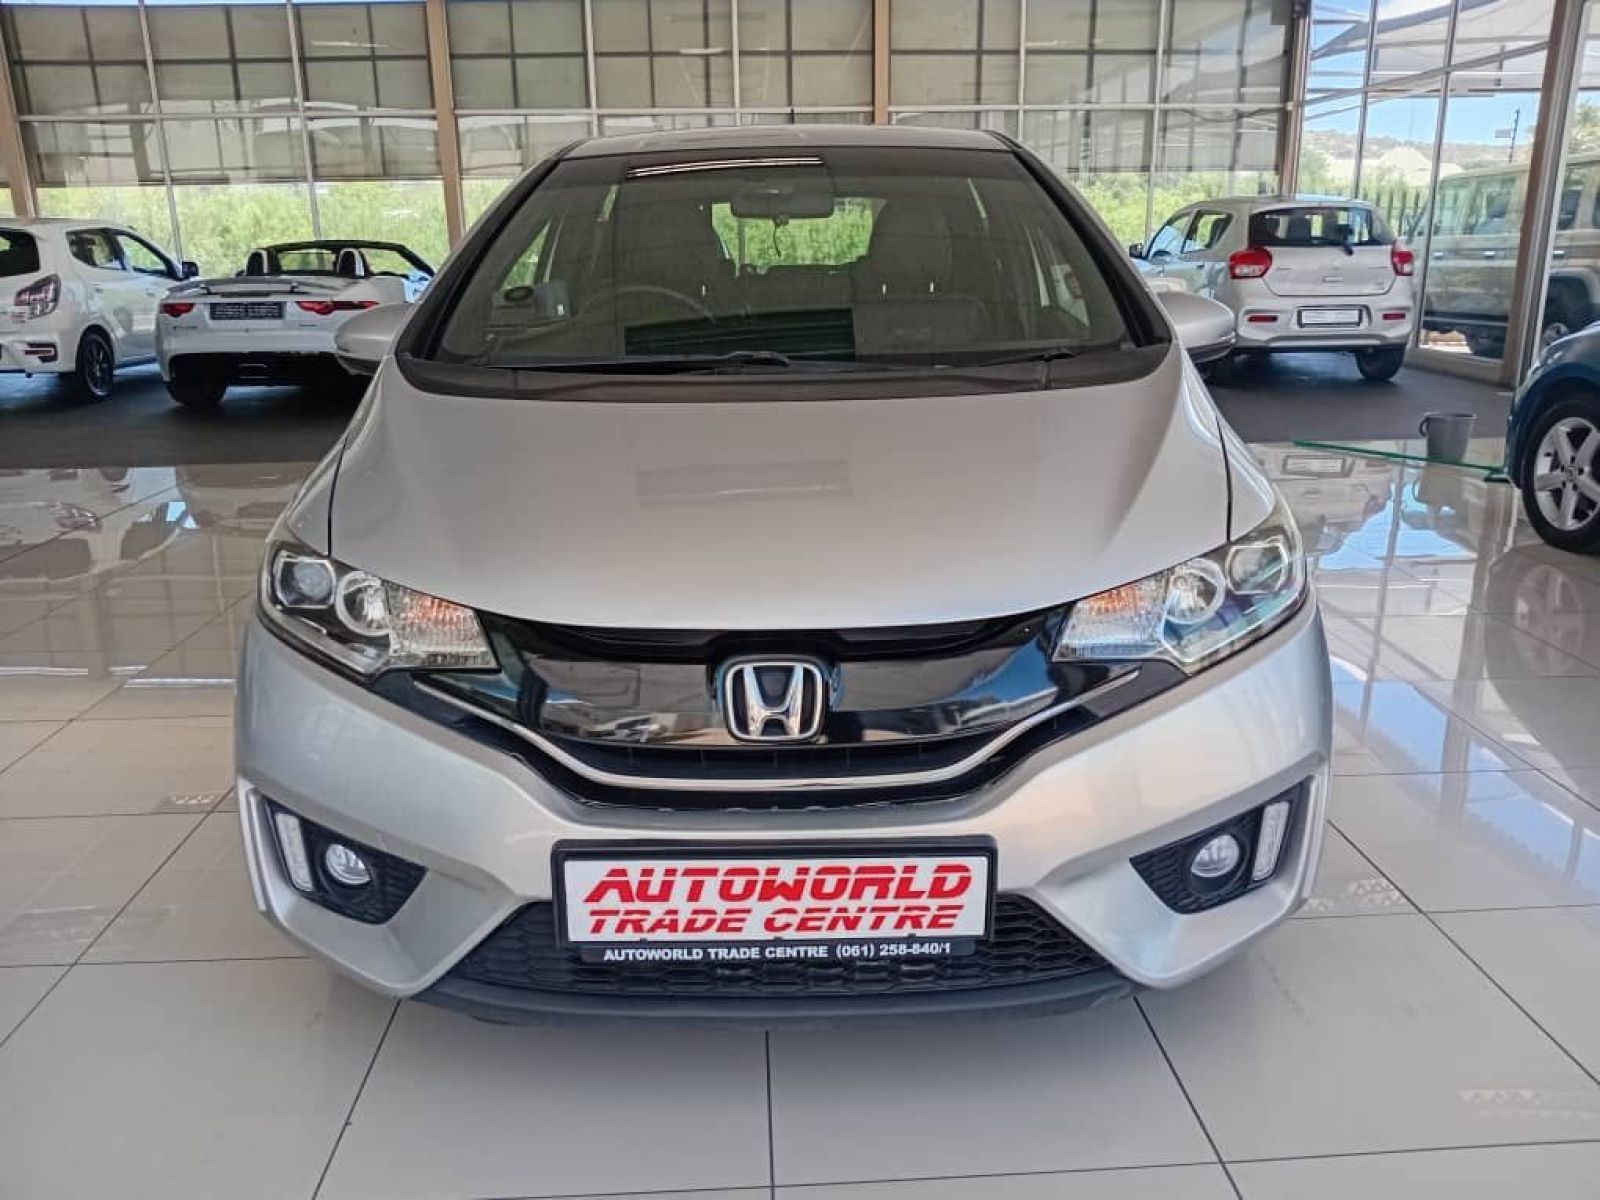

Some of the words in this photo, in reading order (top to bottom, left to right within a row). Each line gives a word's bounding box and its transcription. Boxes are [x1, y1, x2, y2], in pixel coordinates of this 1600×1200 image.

[583, 864, 972, 903] AUTOWORLD
[589, 909, 753, 934] TRADE
[763, 904, 965, 933] CENTRE
[603, 948, 703, 961] AUTOWORLD
[707, 947, 760, 960] TRADE
[765, 945, 829, 959] CENTRE
[835, 943, 874, 959] (061)
